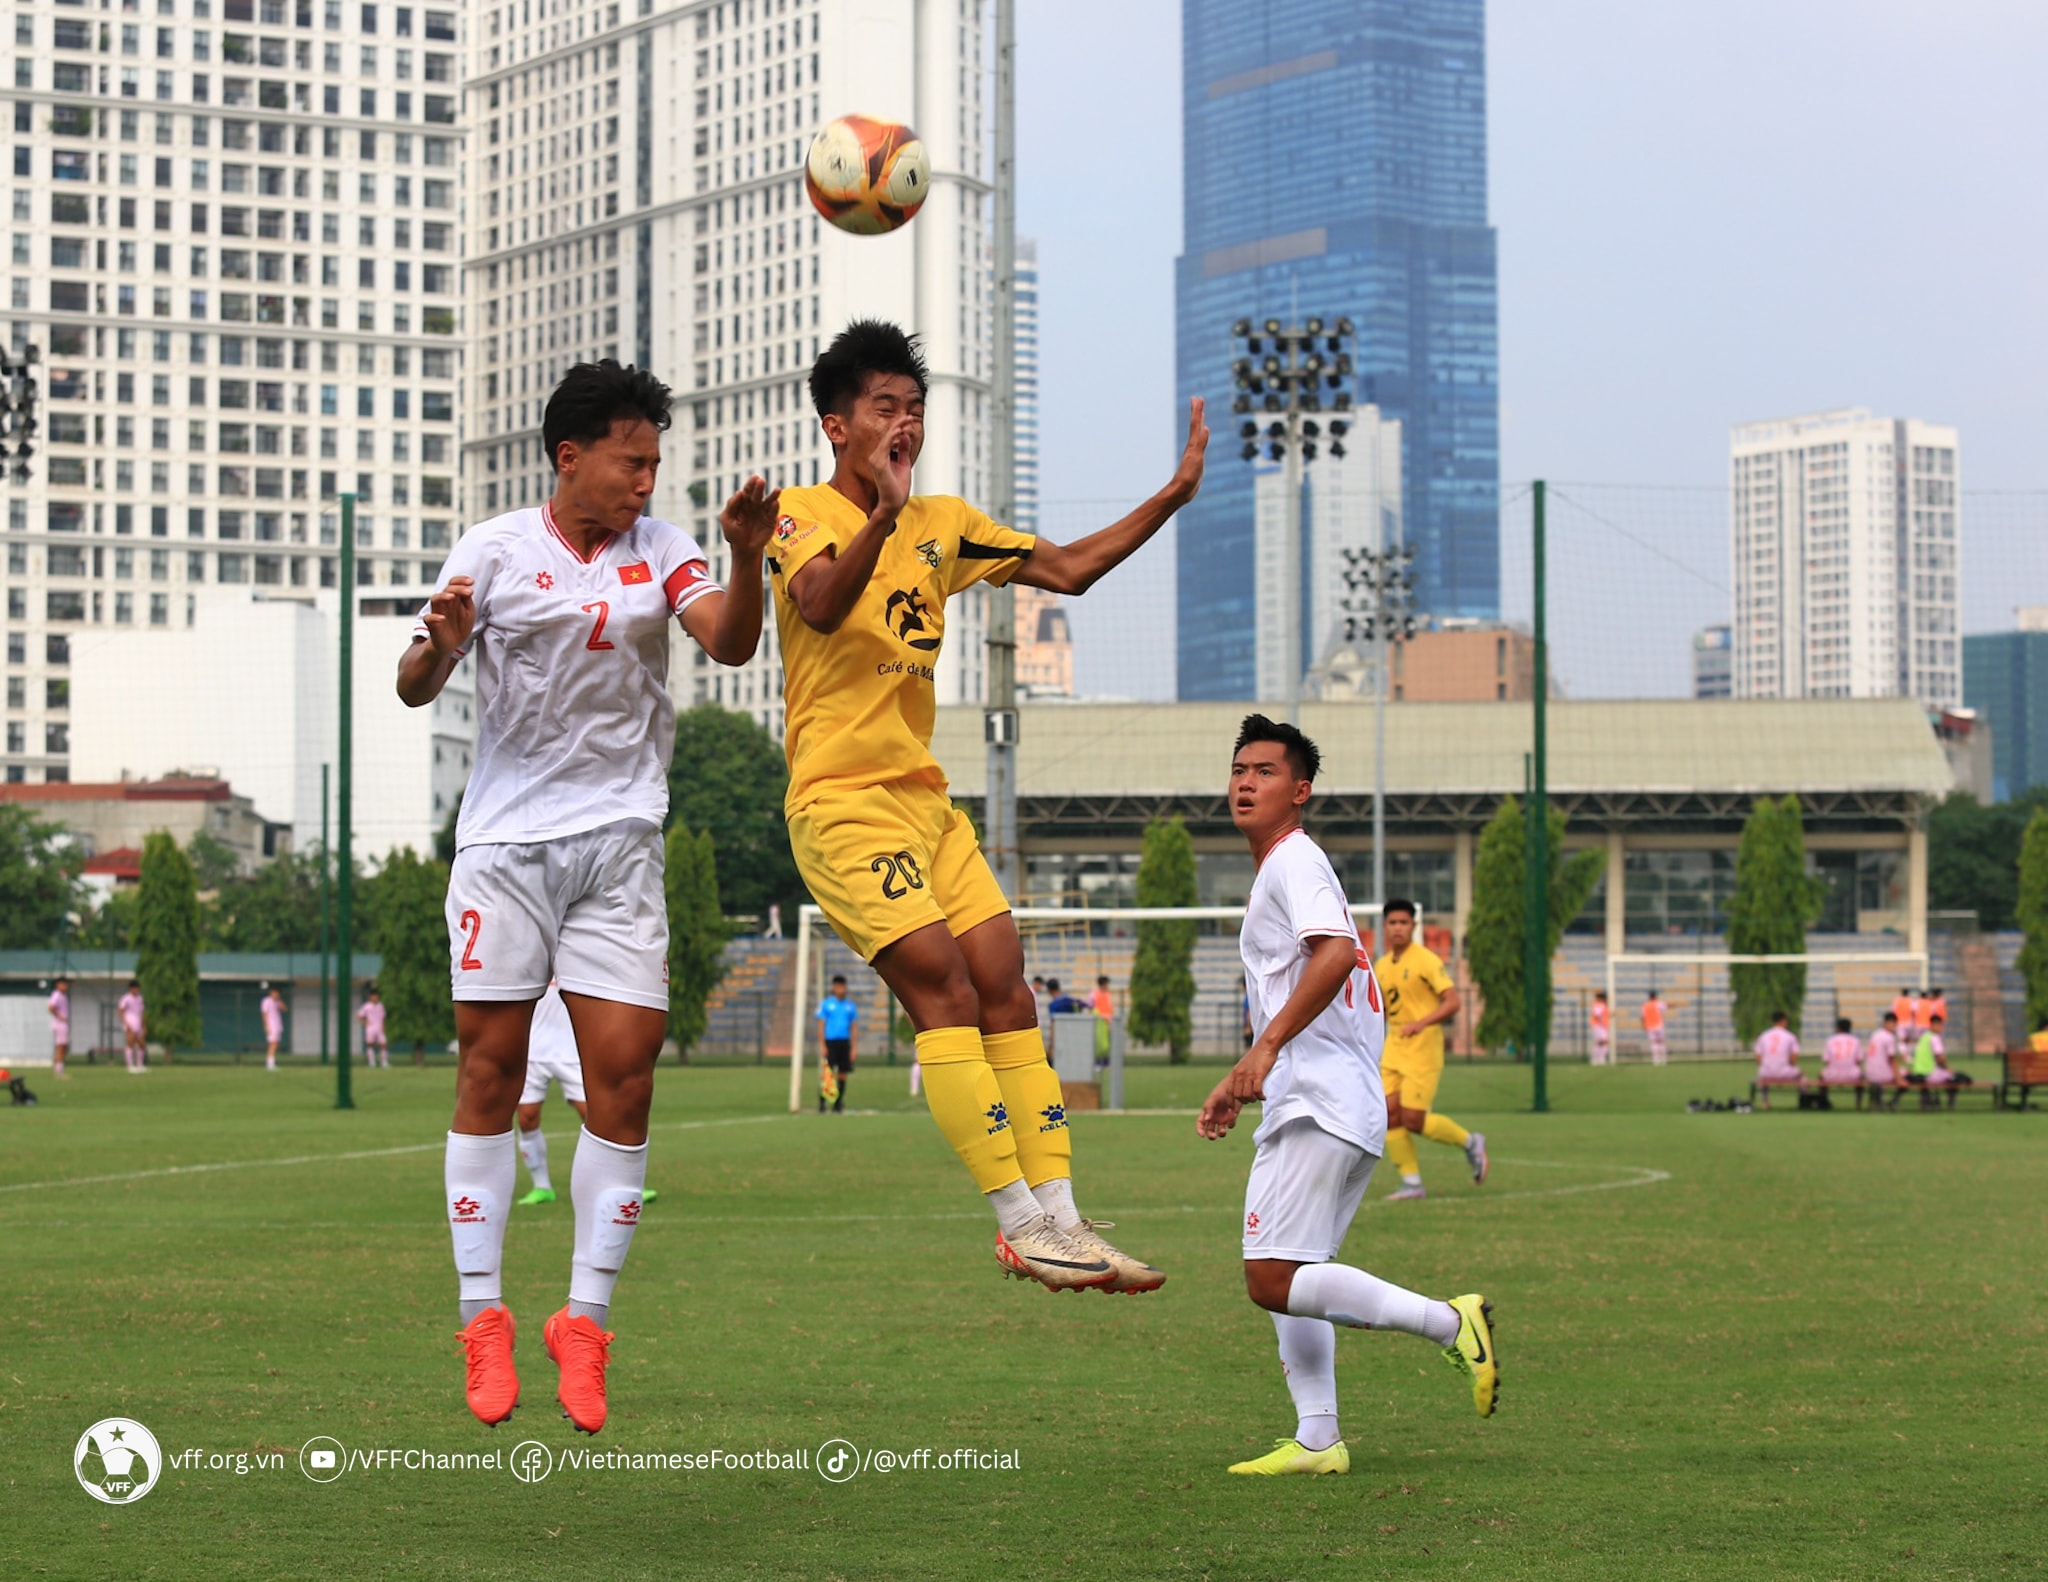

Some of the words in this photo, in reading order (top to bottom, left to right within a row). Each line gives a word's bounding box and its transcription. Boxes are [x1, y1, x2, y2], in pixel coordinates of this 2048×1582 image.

[581, 600, 615, 651] 2
[877, 661, 903, 675] Café
[907, 662, 919, 675] de
[871, 850, 924, 900] 20
[460, 909, 482, 970] 2
